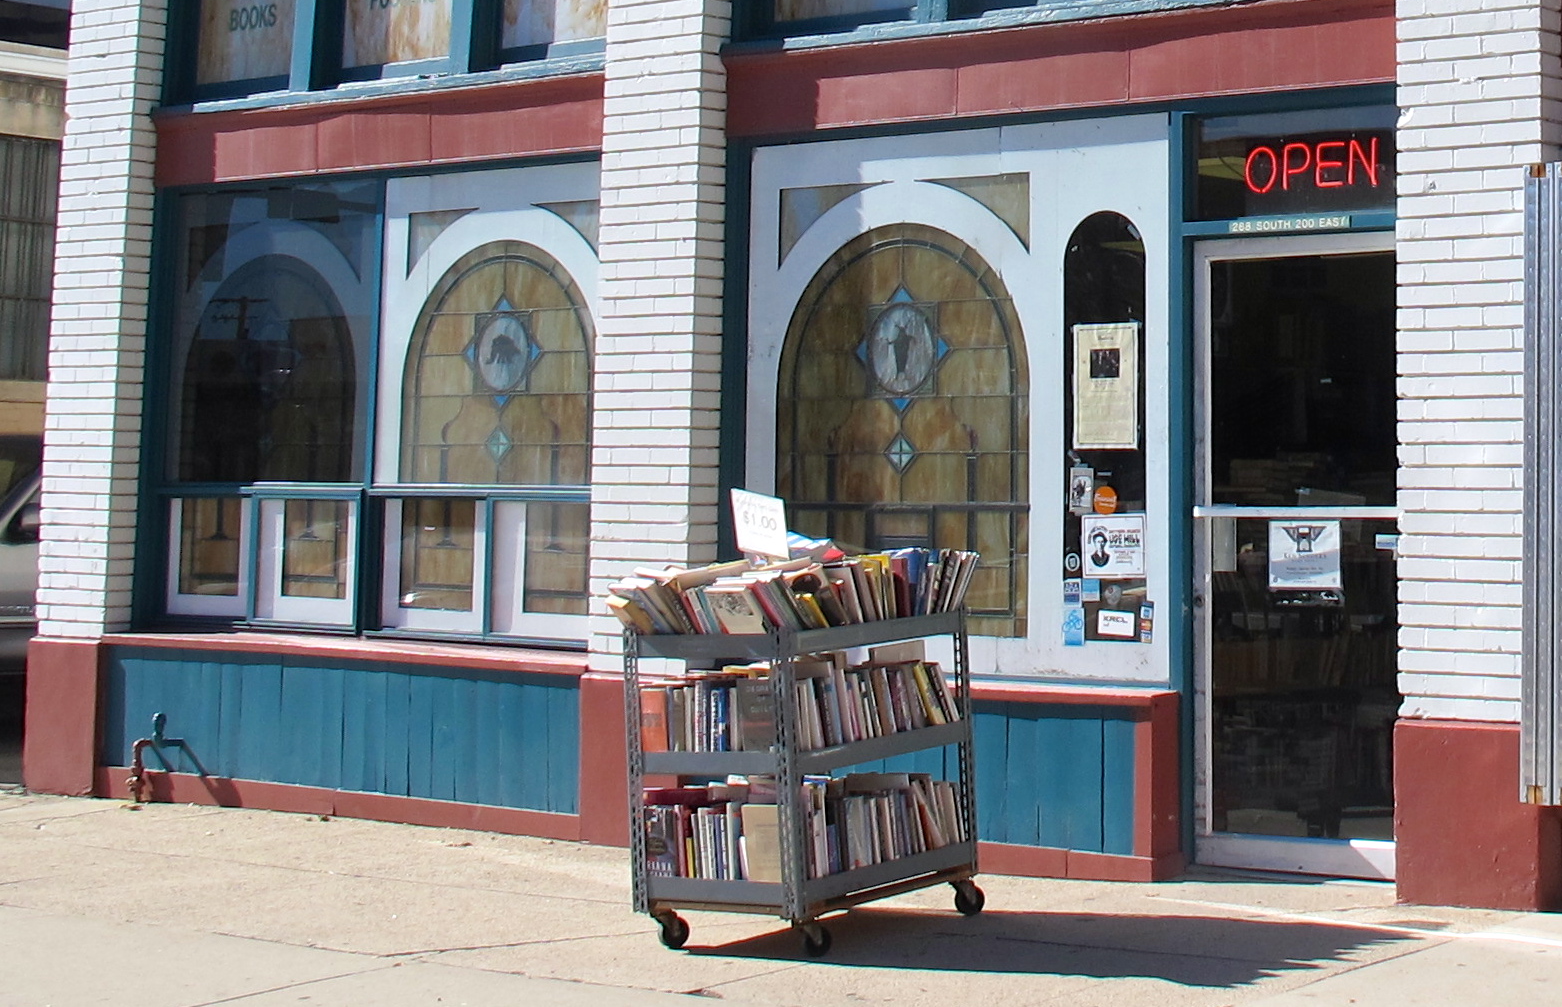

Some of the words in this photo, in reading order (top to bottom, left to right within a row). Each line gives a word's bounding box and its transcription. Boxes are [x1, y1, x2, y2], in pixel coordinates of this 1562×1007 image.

[229, 4, 277, 31] BOOKS
[1244, 137, 1379, 193] OPEN
[1256, 219, 1291, 231] SOUTH
[1295, 218, 1315, 229] 200
[1319, 216, 1345, 228] EAST
[743, 510, 777, 531] $1.00
[1103, 615, 1128, 624] KRCL
